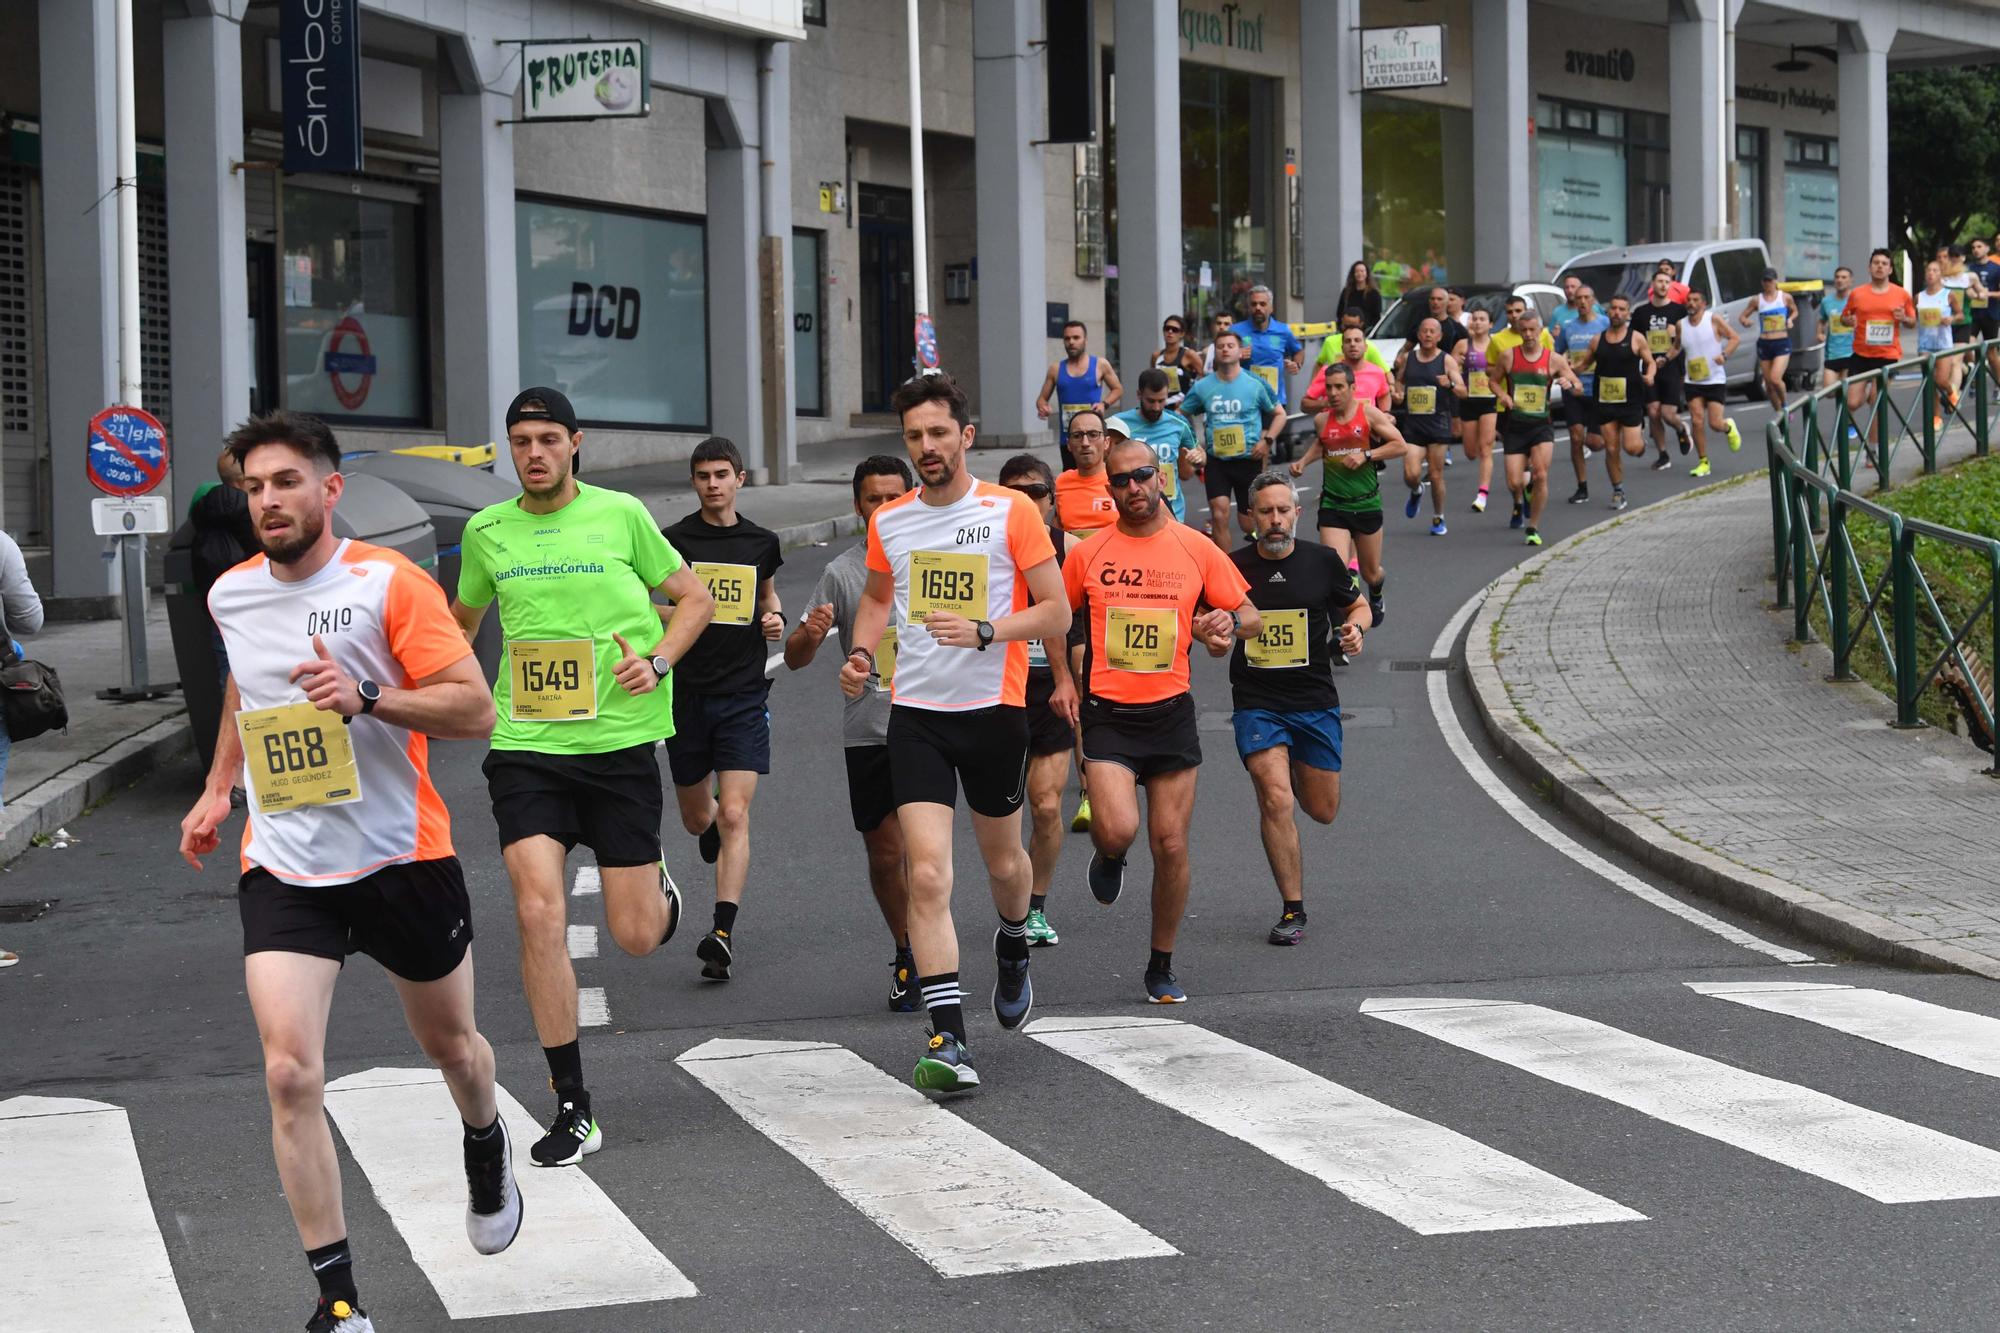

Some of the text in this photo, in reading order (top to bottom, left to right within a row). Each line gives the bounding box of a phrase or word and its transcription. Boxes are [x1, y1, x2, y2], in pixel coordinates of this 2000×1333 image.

[528, 46, 639, 110] FRUTERIA
[568, 281, 641, 340] DCD
[1219, 433, 1237, 447] 501
[956, 526, 991, 545] OXIO
[708, 578, 742, 602] 455
[922, 569, 974, 601] 1693
[308, 607, 352, 637] OXIO
[1125, 624, 1158, 649] 126
[1258, 624, 1293, 647] 435
[522, 659, 579, 691] 1549
[264, 725, 328, 775] 668
